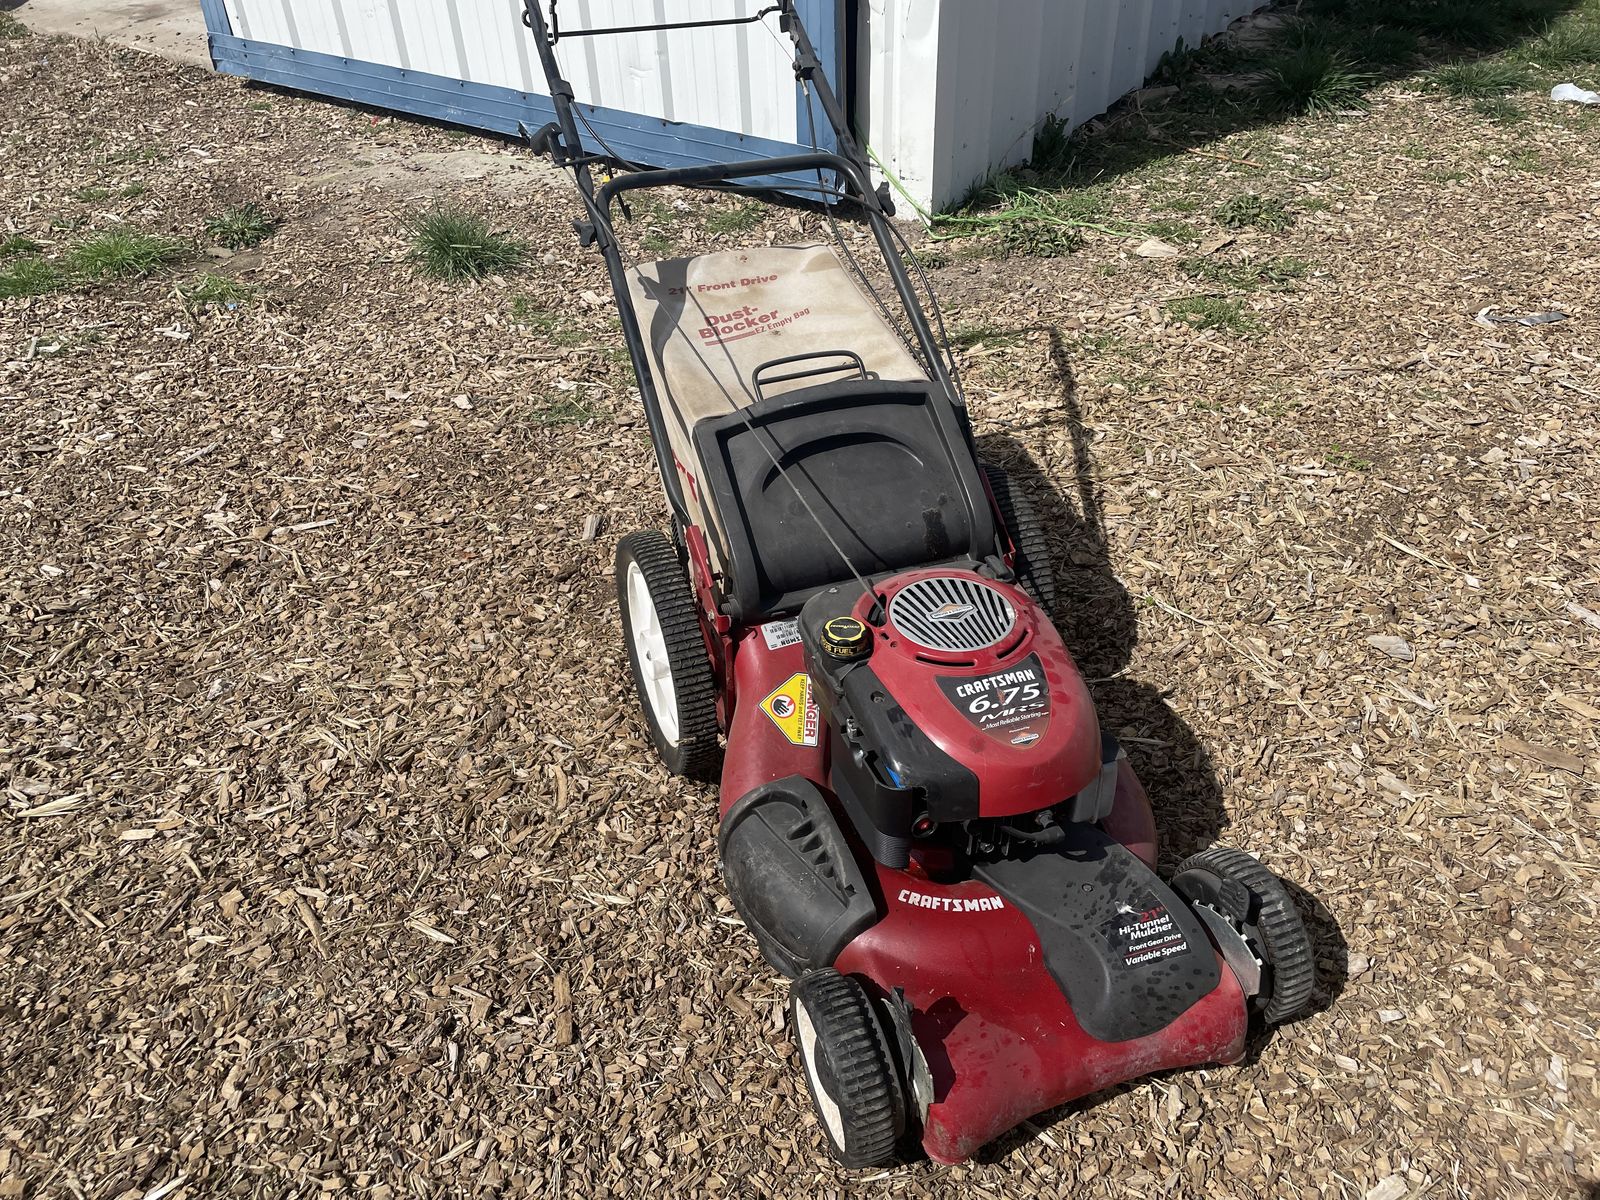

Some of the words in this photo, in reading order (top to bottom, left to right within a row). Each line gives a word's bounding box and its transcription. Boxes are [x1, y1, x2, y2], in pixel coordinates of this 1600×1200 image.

[698, 281, 736, 292] Front
[740, 274, 778, 287] Drive
[698, 309, 779, 339] Blocker
[704, 305, 758, 327] Dust-
[755, 326, 767, 334] EZ
[767, 316, 793, 331] Empty
[793, 307, 810, 319] Bag
[834, 647, 853, 655] FUEL
[956, 669, 1036, 698] CRAFTSMAN
[969, 683, 1040, 713] 6.75
[1000, 716, 1020, 726] Reliable
[1020, 712, 1041, 721] Starting
[898, 889, 1005, 912] CRAFTSMAN
[1119, 914, 1170, 936] Hi-Tunnel
[1140, 906, 1164, 922] 21"
[1129, 942, 1147, 952] Front
[1147, 938, 1163, 947] Gear
[1164, 933, 1182, 942] Drive
[1130, 922, 1173, 941] Mulcher
[1125, 950, 1161, 966] Variable
[1161, 942, 1187, 956] Speed
